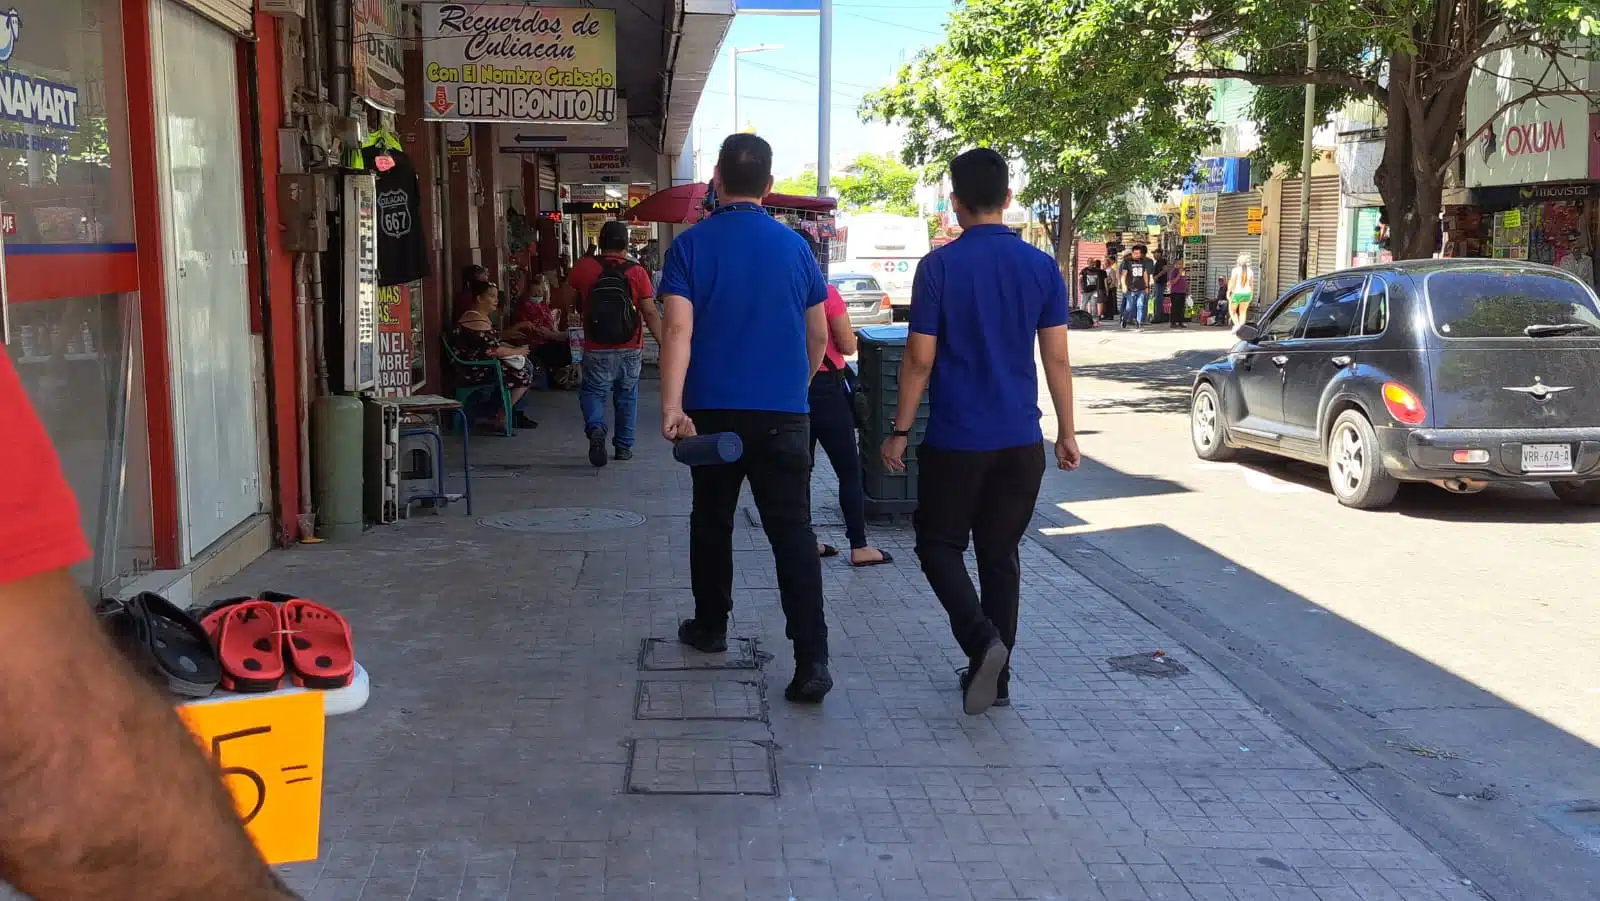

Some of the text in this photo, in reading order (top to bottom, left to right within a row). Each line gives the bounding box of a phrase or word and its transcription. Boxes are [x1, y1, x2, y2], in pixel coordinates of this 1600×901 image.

[438, 5, 601, 37] Recuerdos de
[427, 62, 613, 87] Con El Nombre Grabado
[458, 87, 508, 118] BIEN
[1505, 118, 1565, 156] OXUM
[1535, 185, 1590, 197] movistar
[385, 211, 406, 231] 667
